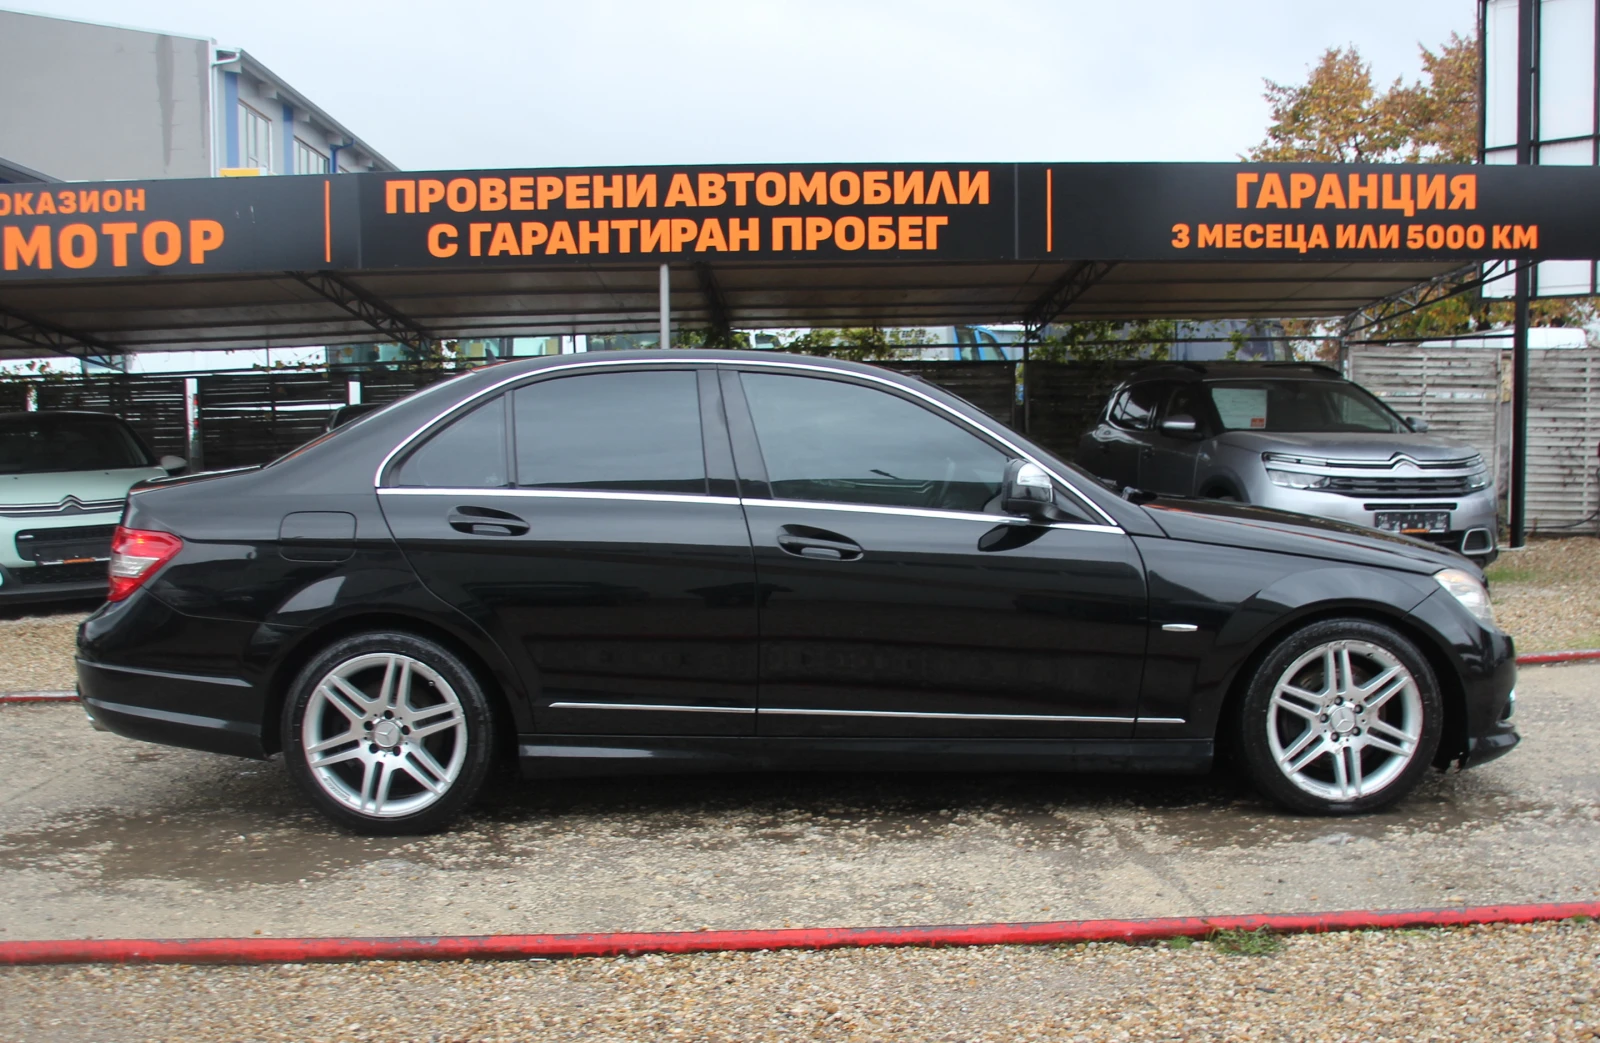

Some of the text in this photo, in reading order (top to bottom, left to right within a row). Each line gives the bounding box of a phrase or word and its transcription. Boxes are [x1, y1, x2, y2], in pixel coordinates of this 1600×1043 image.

[385, 170, 990, 214] ПРОВЕРЕНИ АВТОМОБИЛИ
[1236, 172, 1477, 217] ГАРАНЦИЯ
[3, 219, 225, 271] МОТОР
[427, 215, 949, 258] С ГАРАНТИРАН ПРОБЕГ
[1171, 223, 1538, 254] 3 МЕСЕЦА ИЛИ 5000 КМ
